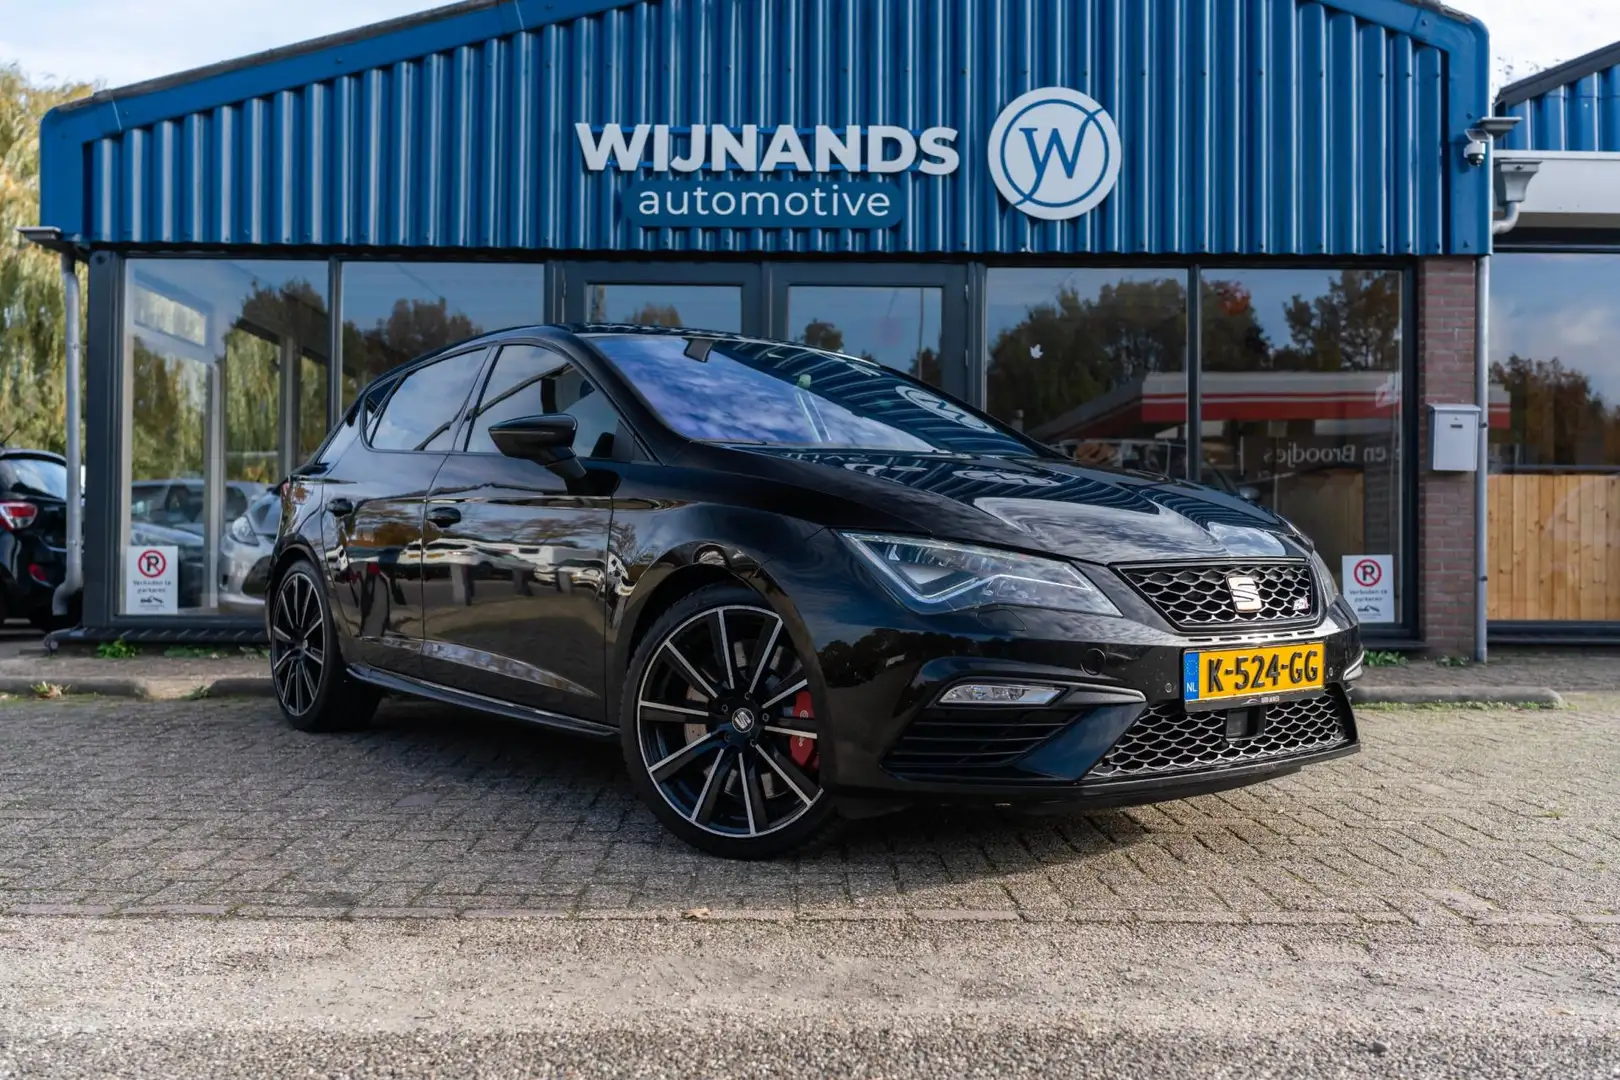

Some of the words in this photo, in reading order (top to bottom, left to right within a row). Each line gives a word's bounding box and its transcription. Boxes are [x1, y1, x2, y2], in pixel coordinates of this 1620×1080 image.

[574, 123, 960, 176] WIJNANDS
[638, 184, 891, 216] automotive
[1186, 682, 1197, 693] NL
[1207, 650, 1318, 693] K-524-GG
